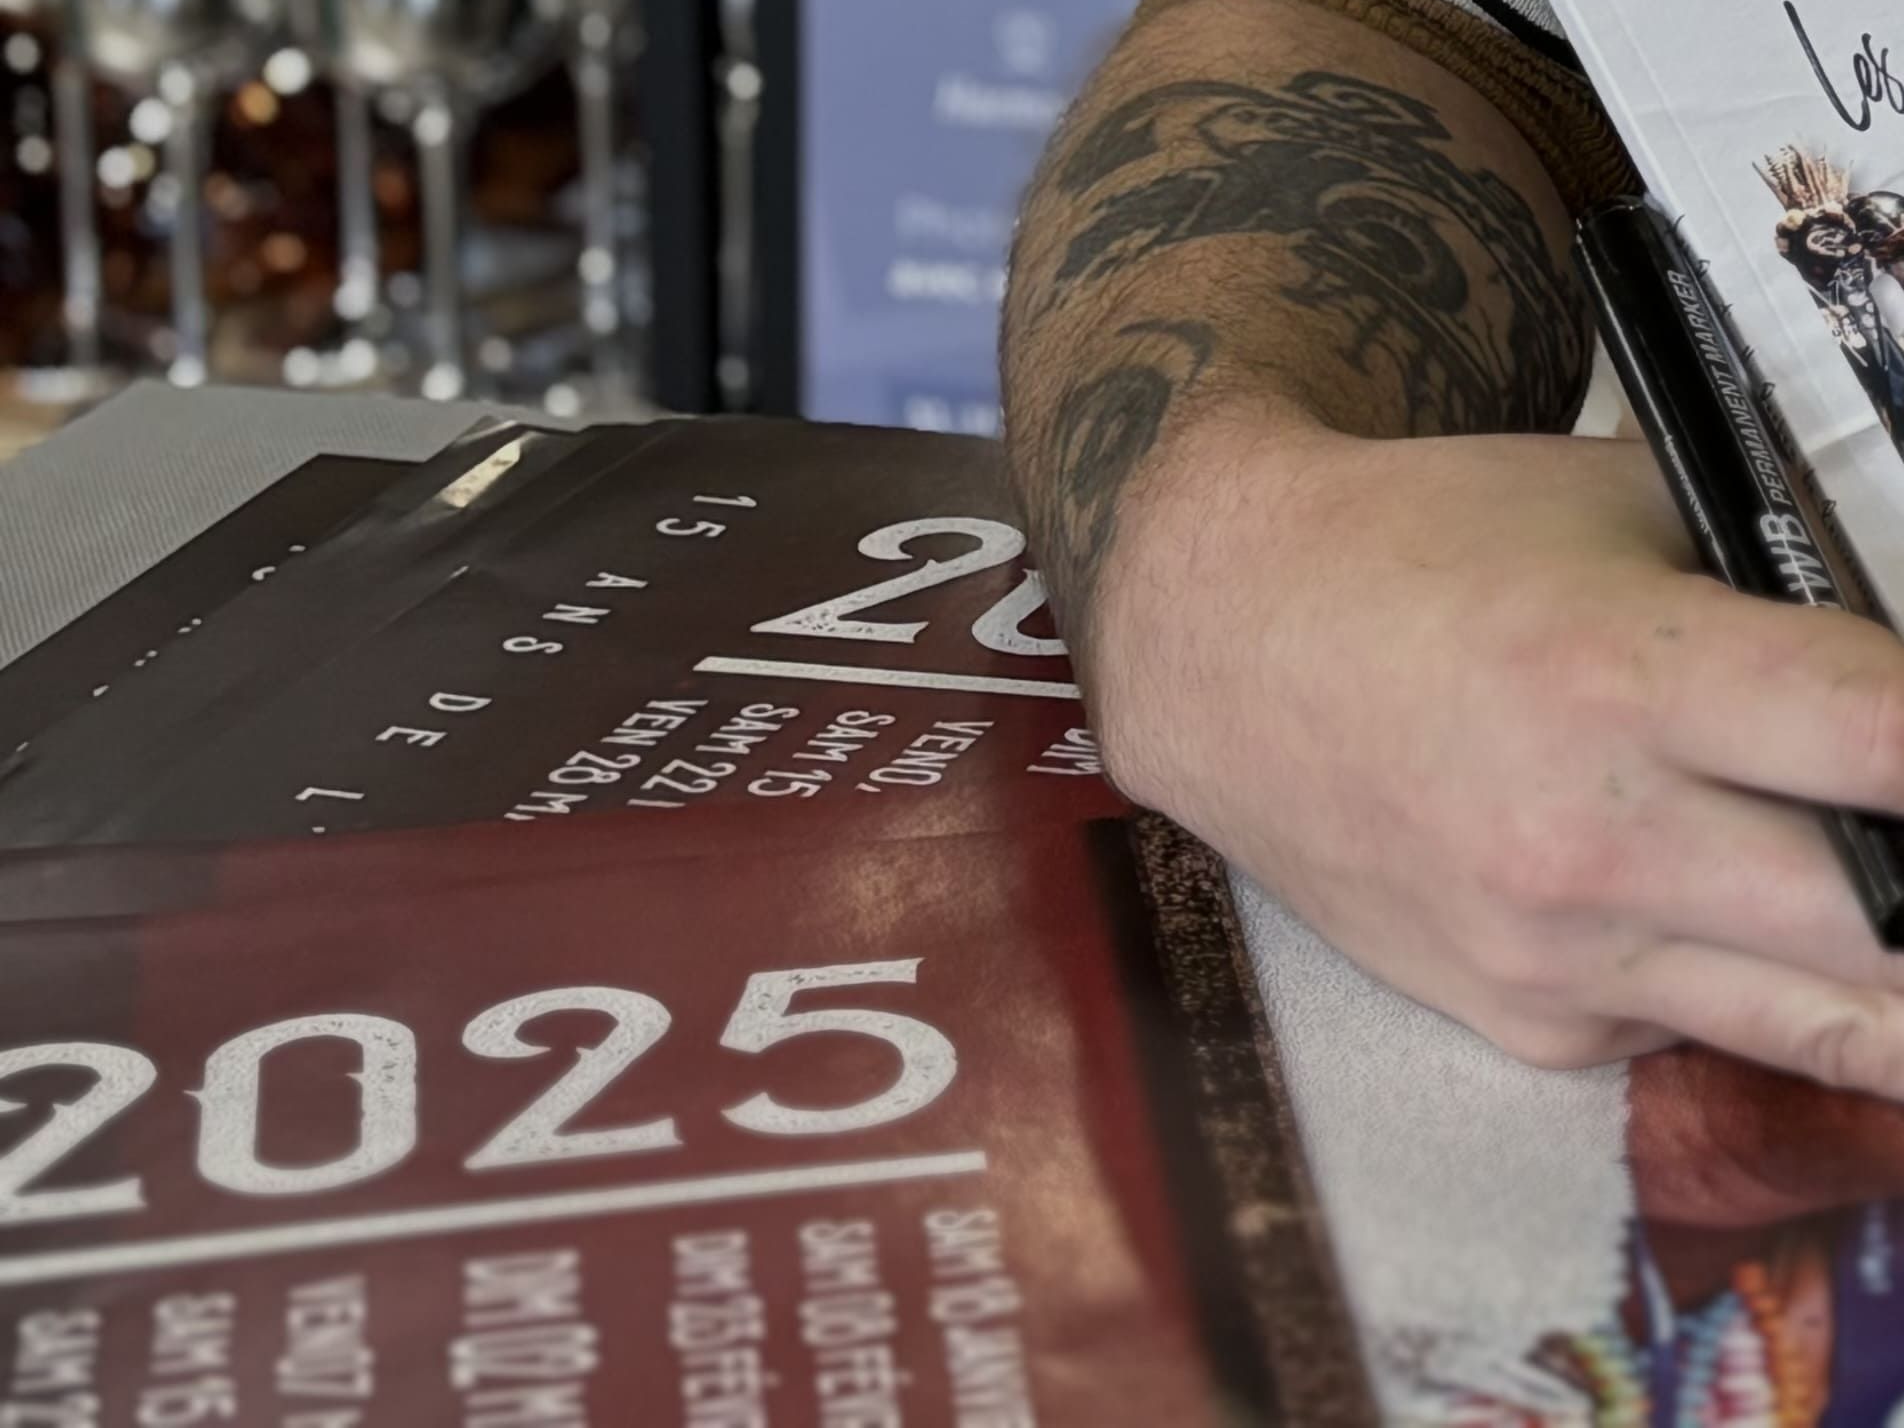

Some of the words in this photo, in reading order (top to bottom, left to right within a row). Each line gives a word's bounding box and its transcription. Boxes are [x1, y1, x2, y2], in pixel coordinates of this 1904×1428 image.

[1667, 268, 1728, 362] MARKER
[1706, 362, 1793, 506] PERMANENT
[503, 572, 648, 653] ANS
[375, 692, 491, 746] DE
[601, 700, 708, 746] VEN
[696, 703, 799, 755] SAM
[792, 710, 896, 762] SAM
[547, 751, 640, 784] 28
[641, 758, 736, 794] 22
[747, 770, 832, 798] 15
[0, 957, 957, 1225] 2025
[799, 1219, 879, 1291] SAM
[925, 1209, 1004, 1277] SAM
